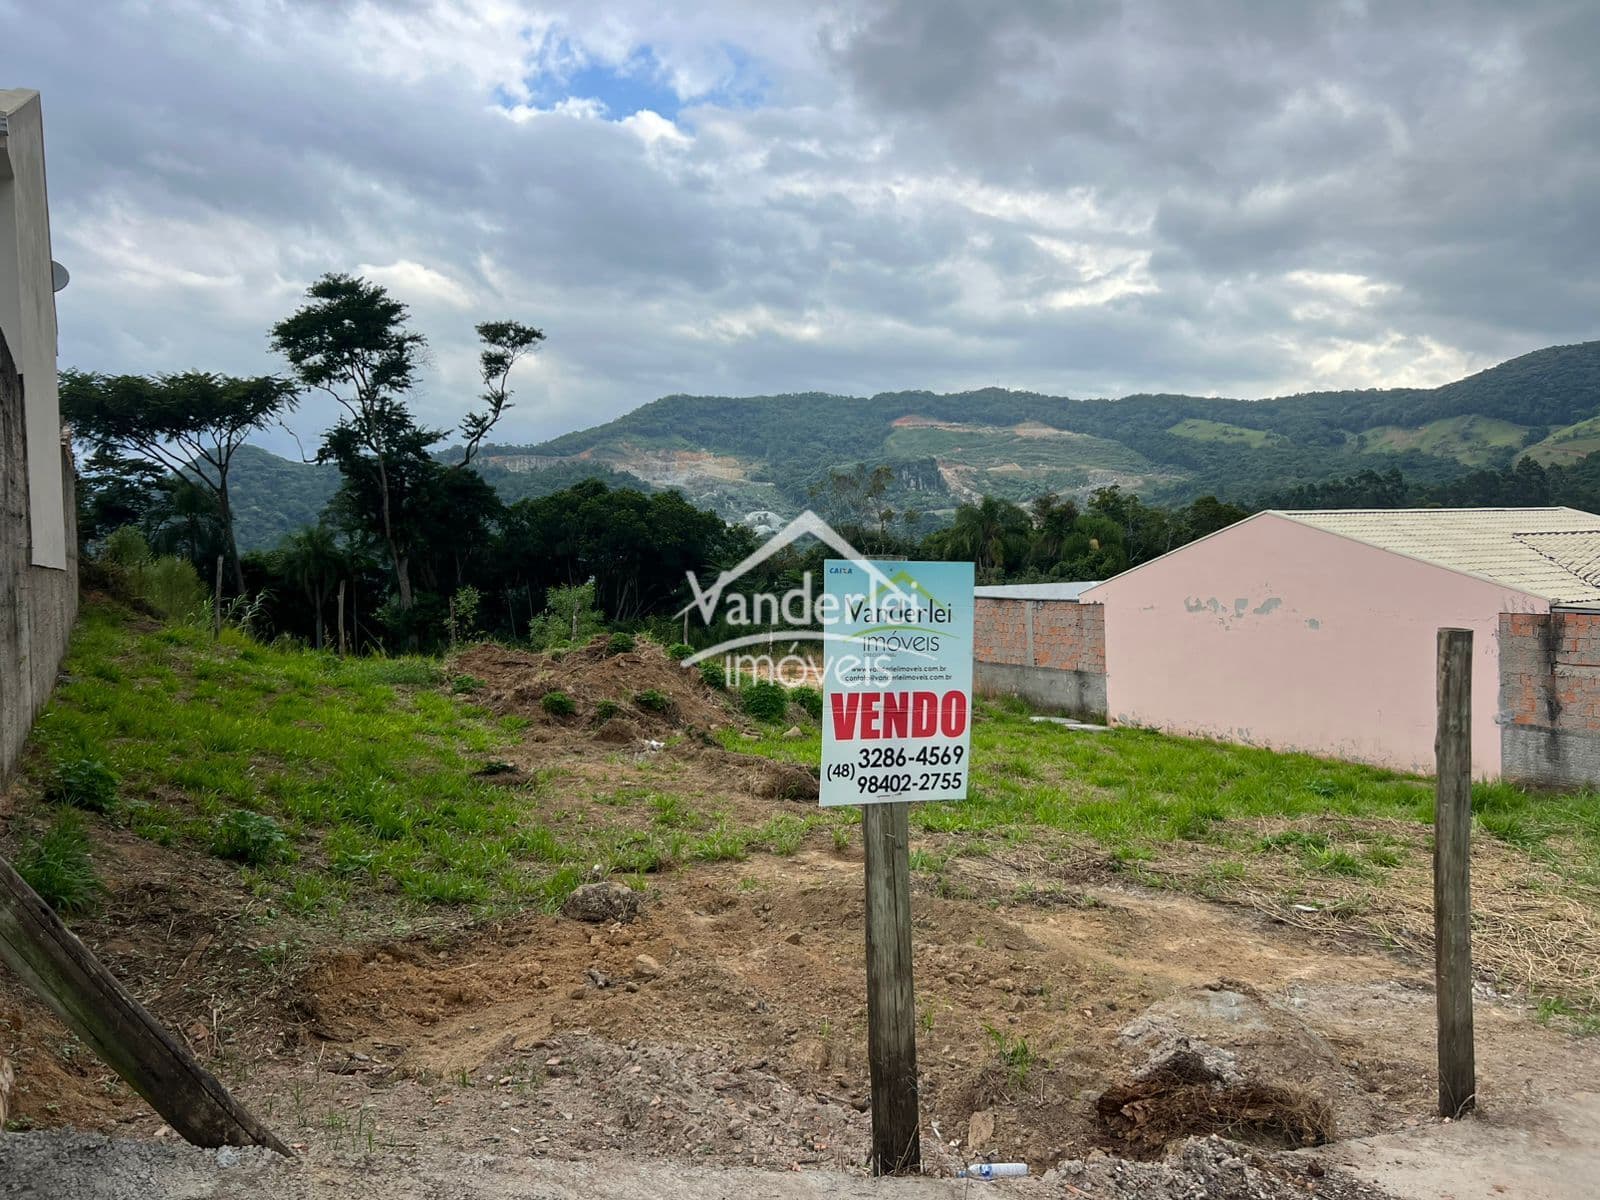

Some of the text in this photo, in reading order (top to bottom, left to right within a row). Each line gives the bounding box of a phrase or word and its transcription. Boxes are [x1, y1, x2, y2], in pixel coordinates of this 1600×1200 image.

[846, 598, 952, 624] Vanderlei
[862, 631, 940, 652] imóveis
[830, 690, 967, 741] VENDO
[857, 745, 964, 769] 3286-4569
[827, 762, 856, 782] (48)
[857, 772, 962, 794] 98402-2755
